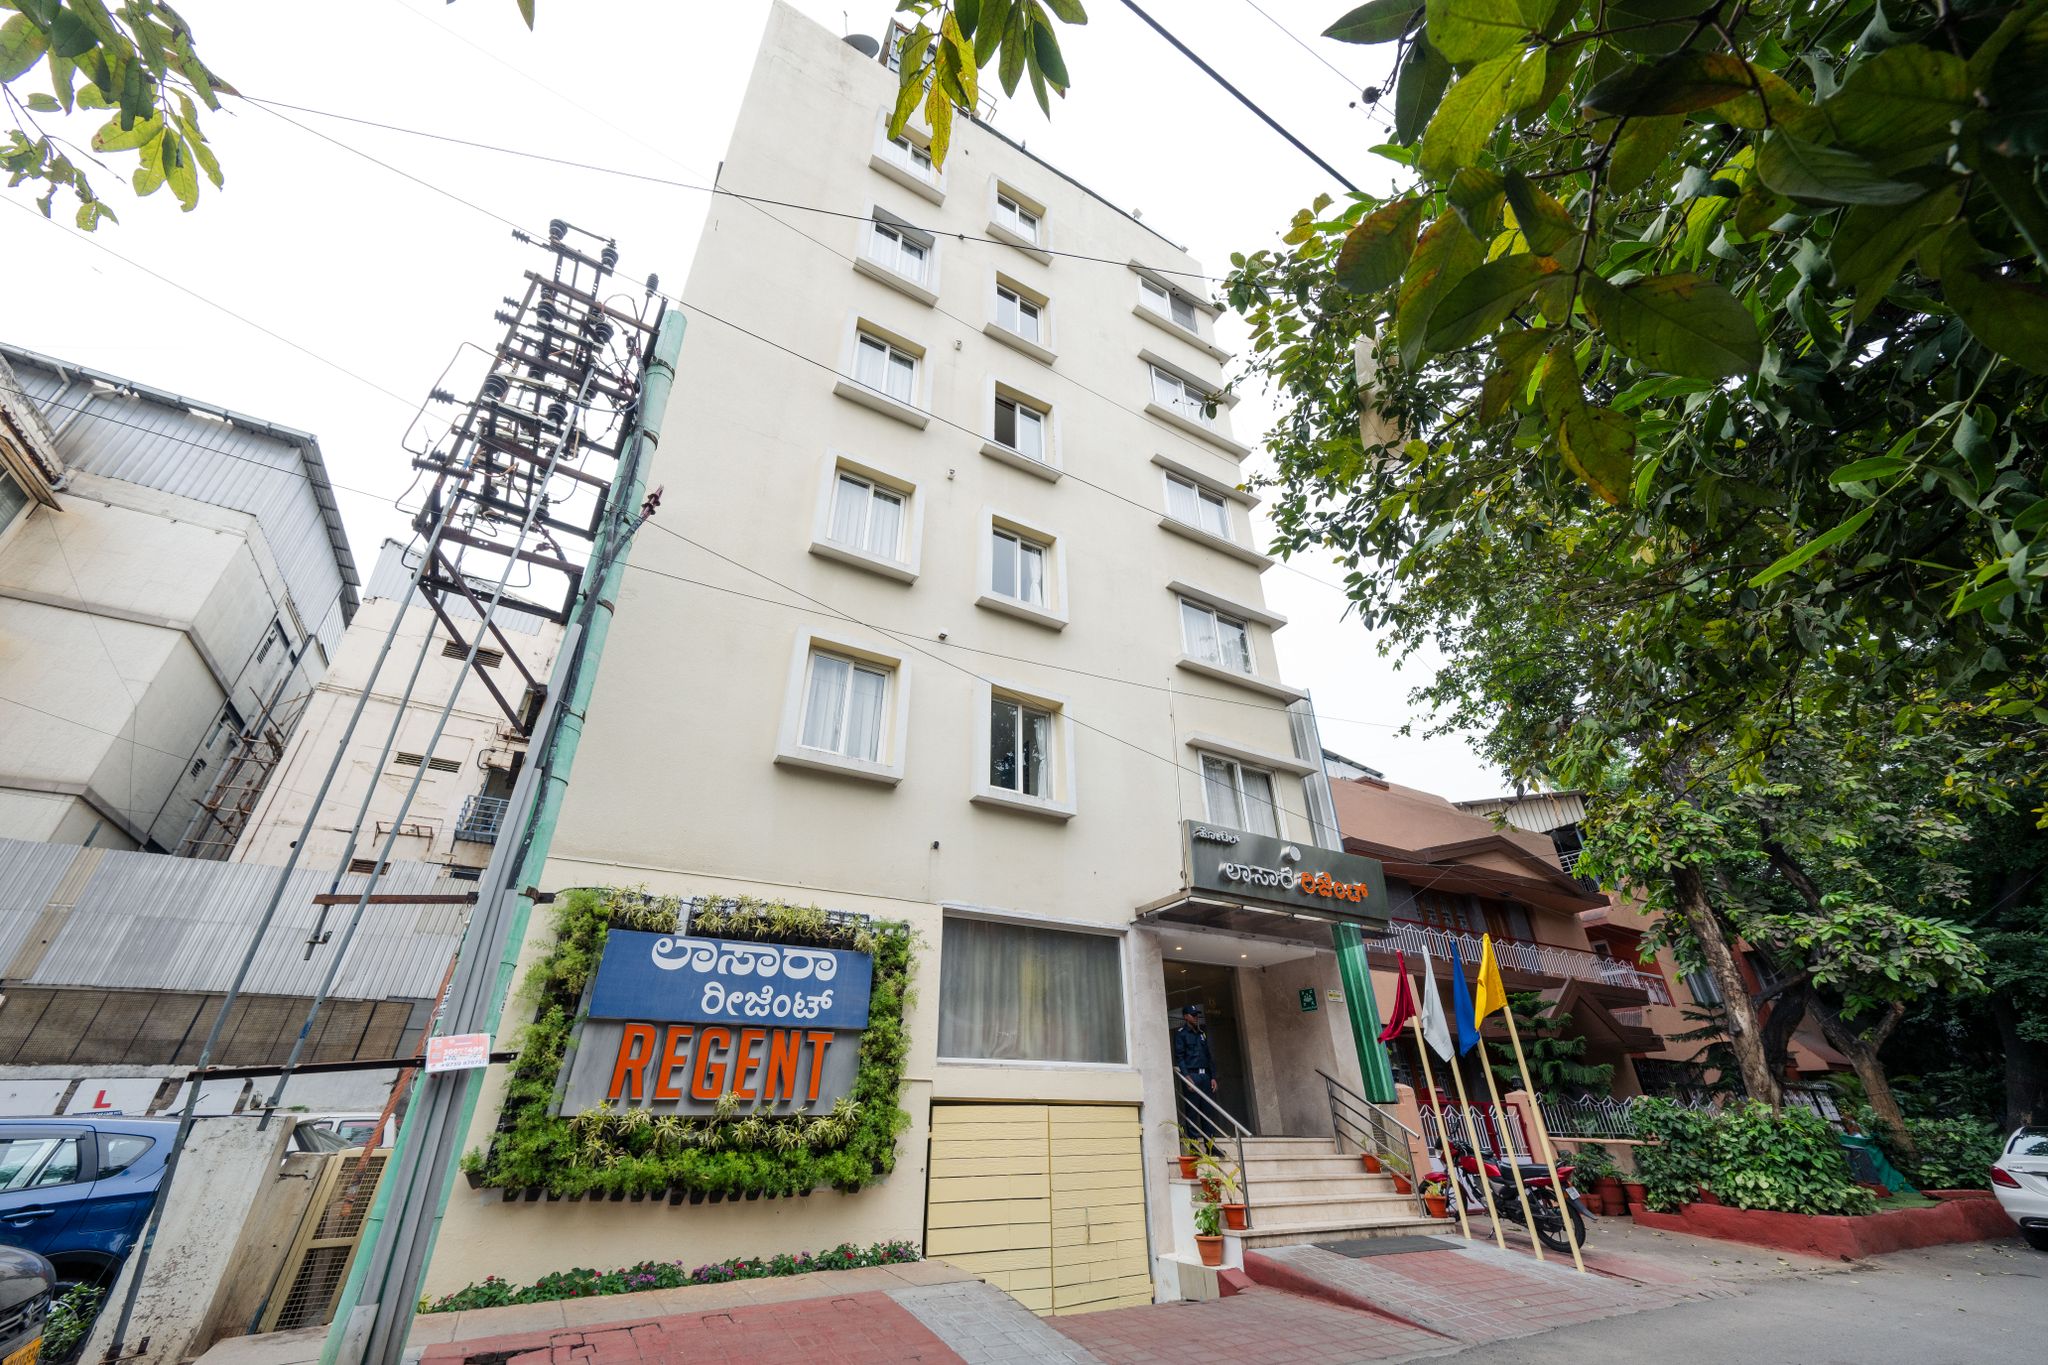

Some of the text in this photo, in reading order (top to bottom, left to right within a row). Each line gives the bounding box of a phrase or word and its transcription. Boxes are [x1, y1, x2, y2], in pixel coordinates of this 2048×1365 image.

[651, 937, 838, 981] ಲಾಸಾರಾ
[701, 981, 834, 1019] ರೀಜೆಂಟ್
[607, 1022, 835, 1101] REGENT
[93, 1089, 112, 1109] L
